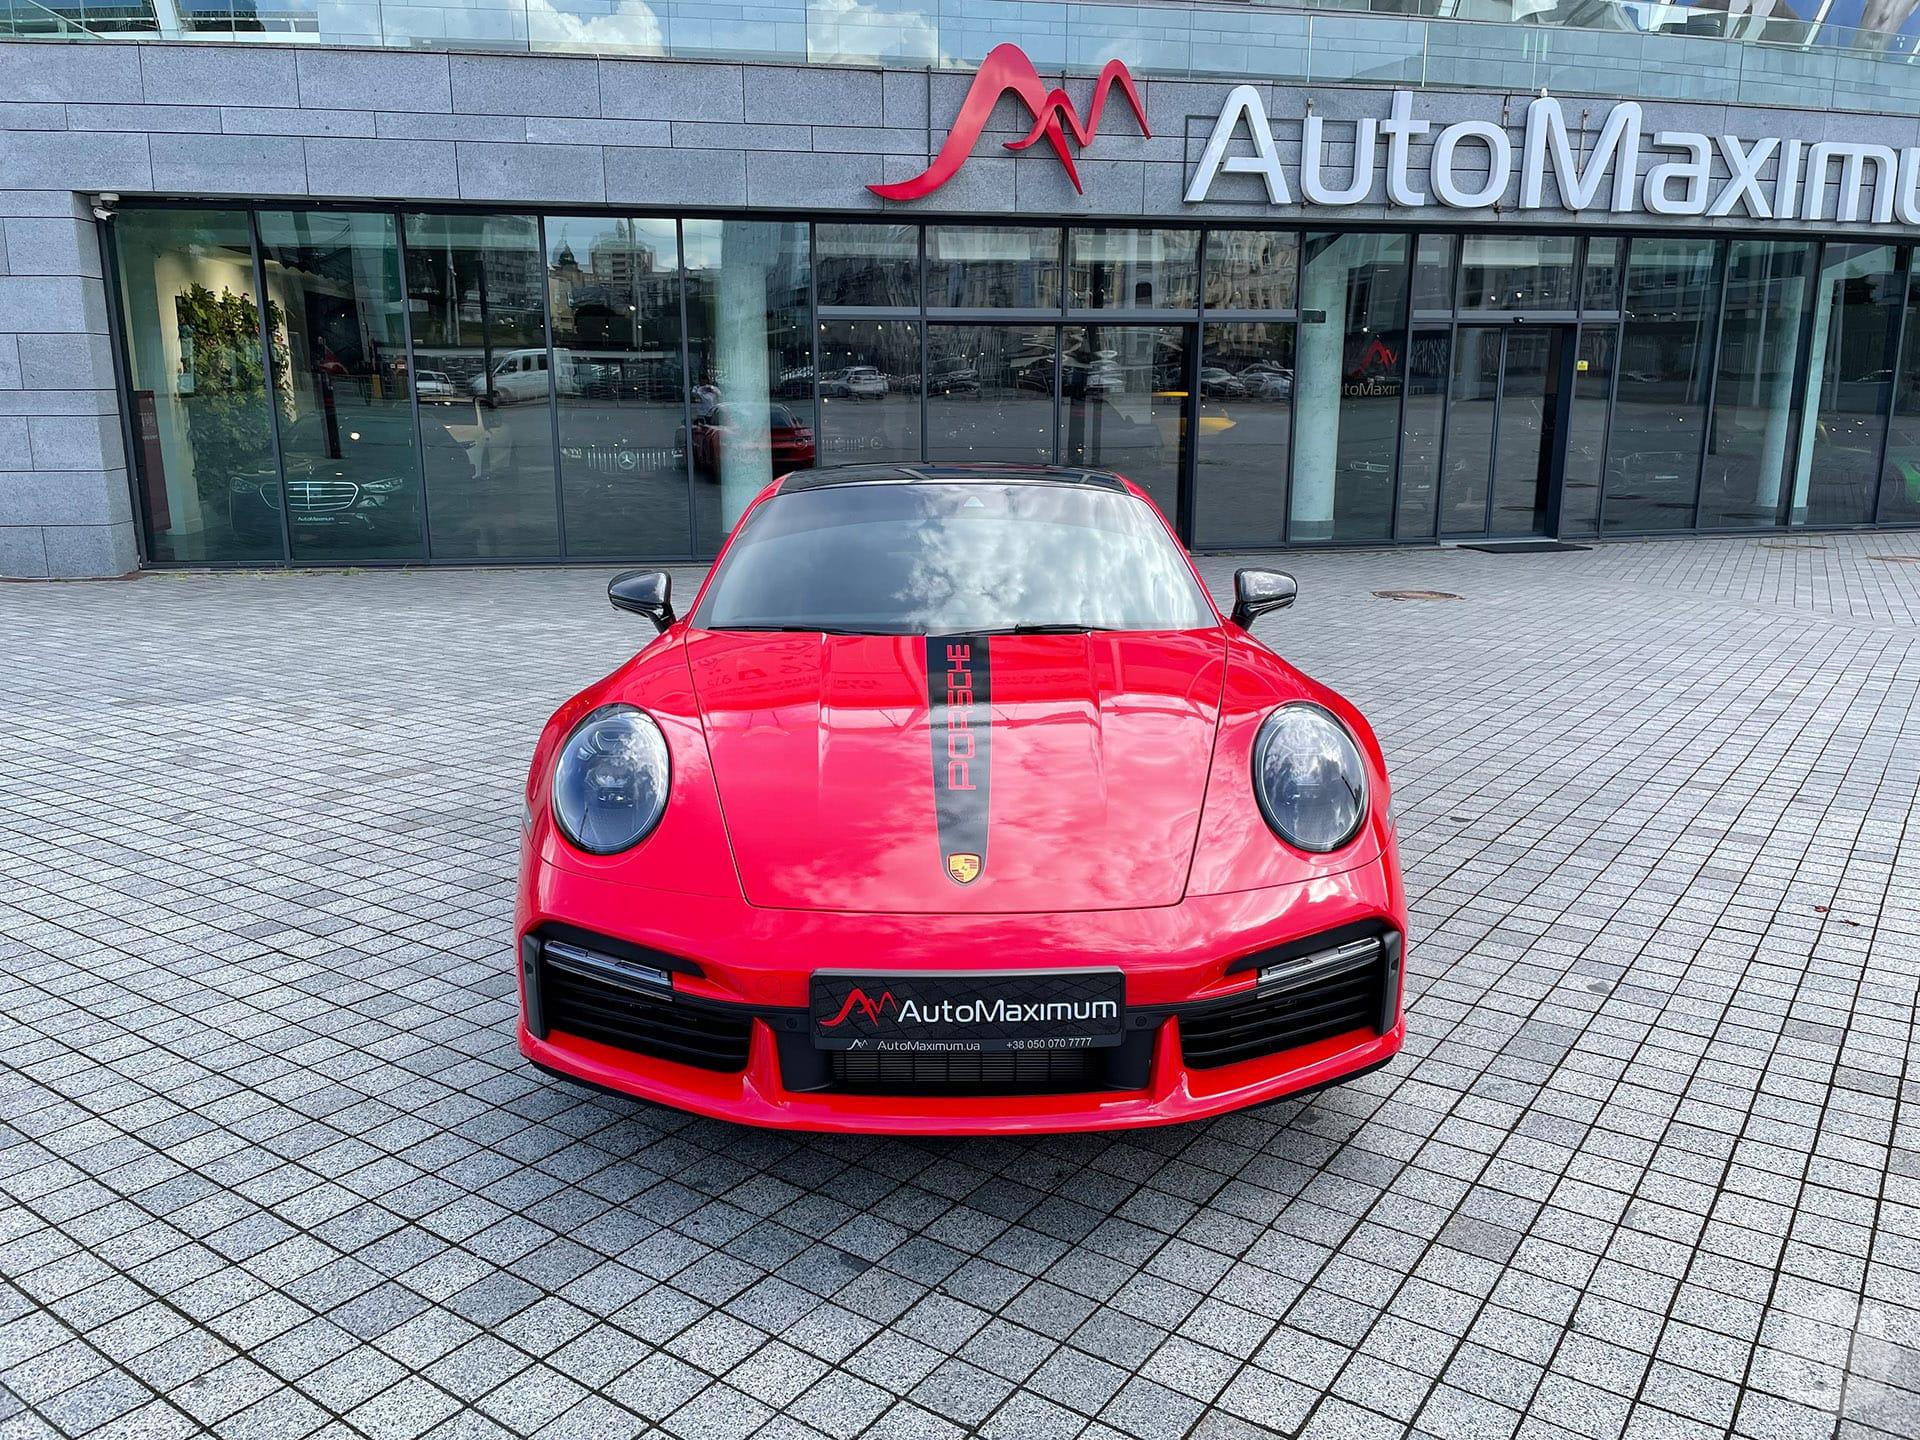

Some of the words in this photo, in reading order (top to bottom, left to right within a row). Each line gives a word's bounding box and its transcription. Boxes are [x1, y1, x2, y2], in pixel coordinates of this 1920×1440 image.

[946, 644, 976, 791] PORSCHE
[898, 999, 1118, 1023] AutoMaximum
[878, 1039, 981, 1051] AutoMaximum.ua
[1006, 1039, 1024, 1050] +38
[1027, 1039, 1045, 1050] 050
[1047, 1038, 1066, 1049] 070
[1068, 1037, 1092, 1048] 7777
